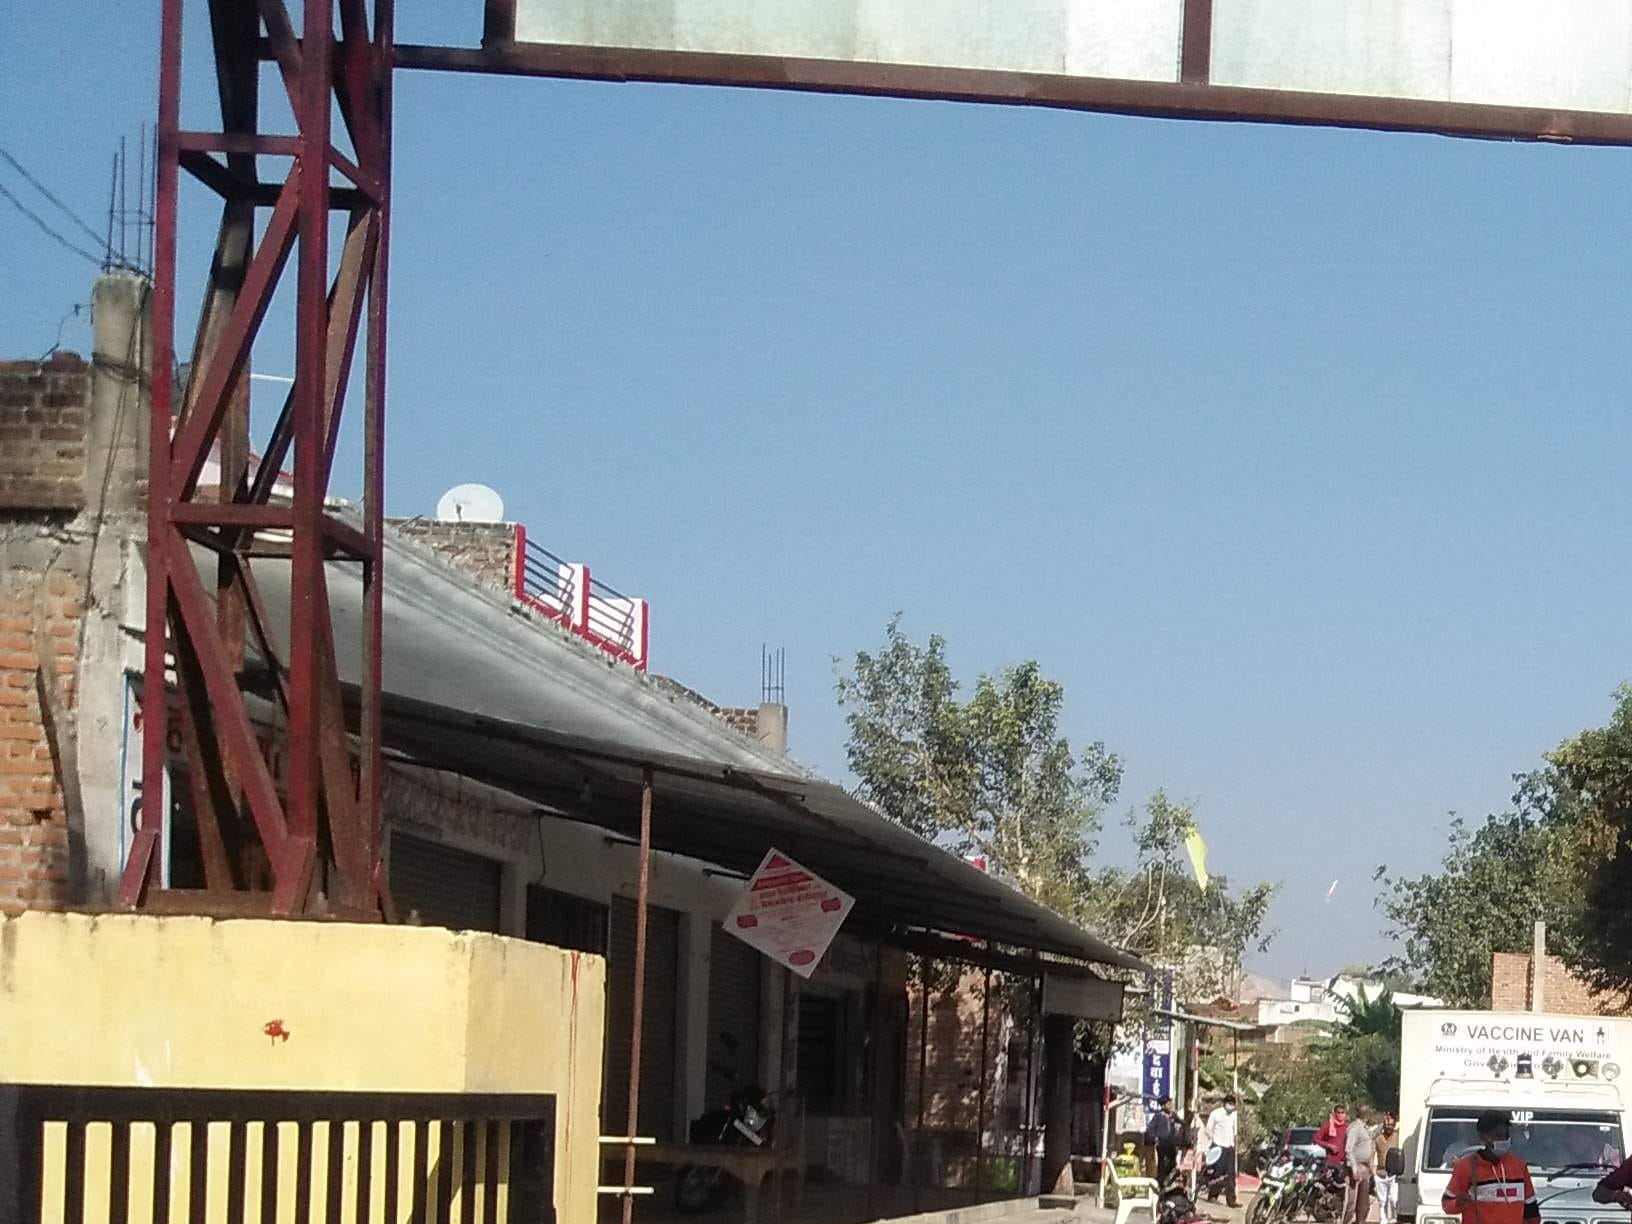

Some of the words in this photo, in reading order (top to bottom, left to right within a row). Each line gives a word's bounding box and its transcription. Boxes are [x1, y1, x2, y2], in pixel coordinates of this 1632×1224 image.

[1467, 1025, 1544, 1041] VACCINE
[1549, 1028, 1584, 1043] VAN
[1435, 1045, 1473, 1056] Ministry
[1476, 1047, 1486, 1055] of
[1576, 1051, 1611, 1059] Welfare
[1511, 1111, 1534, 1121] VIP
